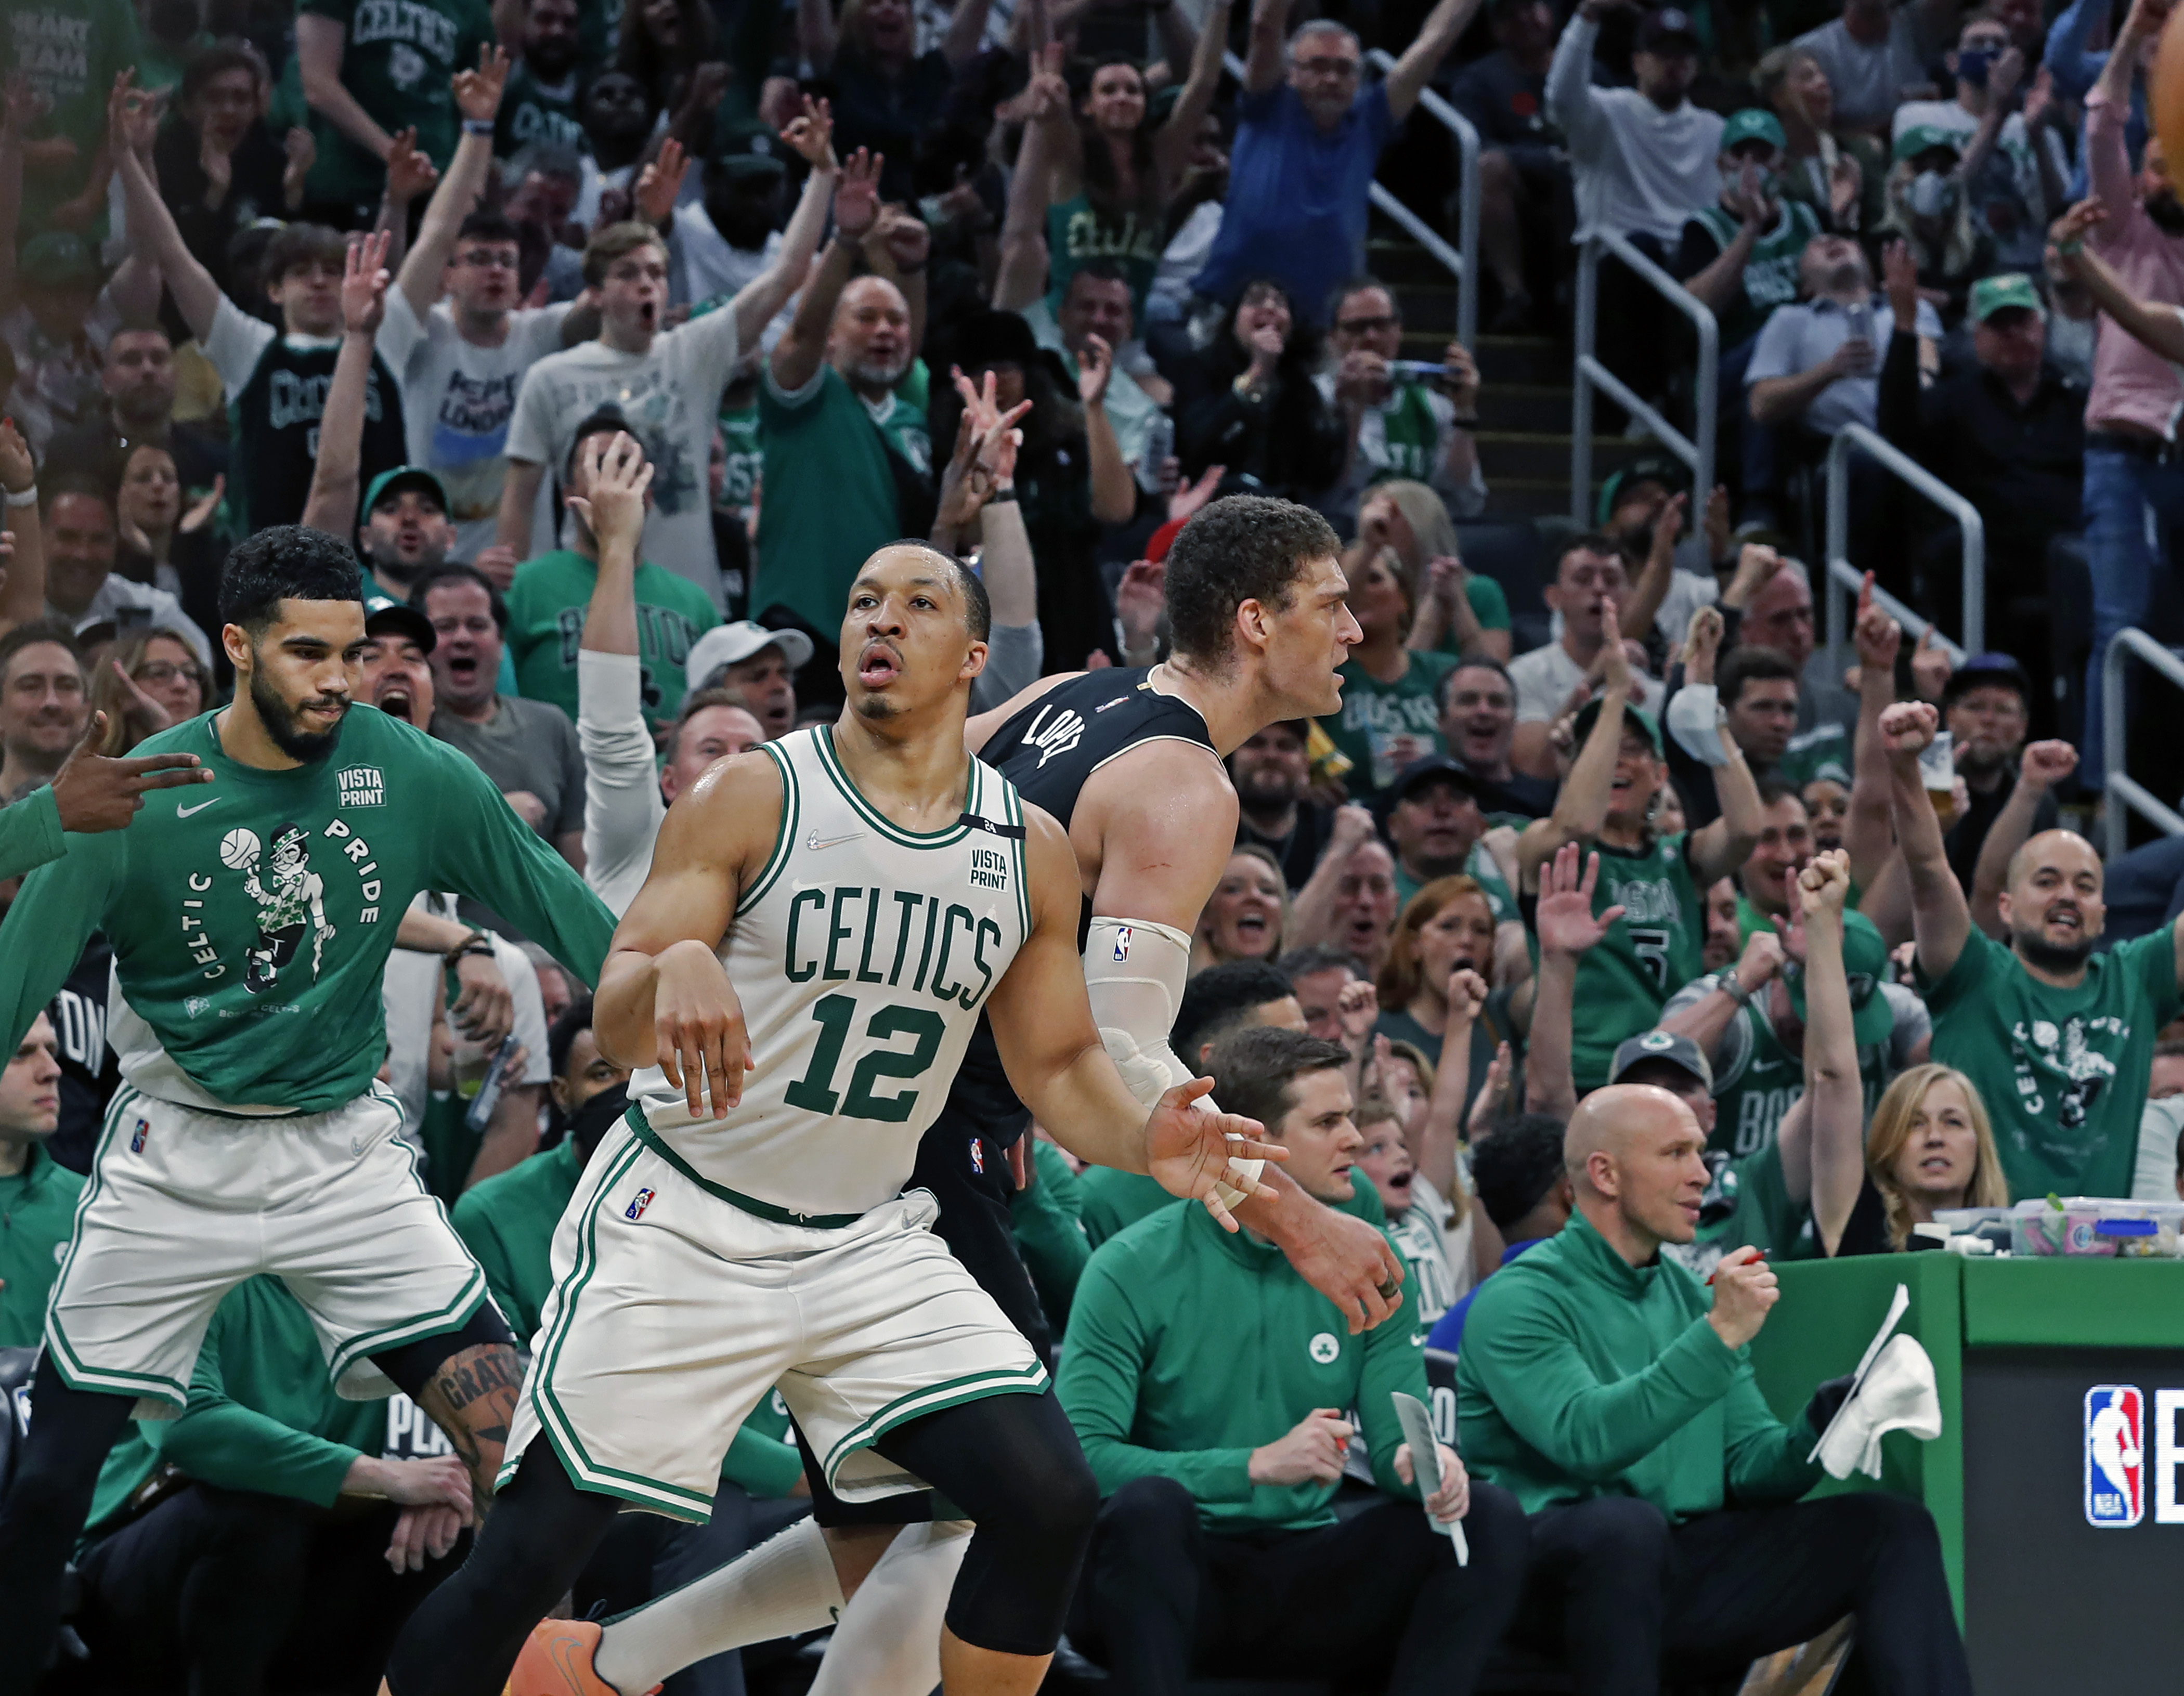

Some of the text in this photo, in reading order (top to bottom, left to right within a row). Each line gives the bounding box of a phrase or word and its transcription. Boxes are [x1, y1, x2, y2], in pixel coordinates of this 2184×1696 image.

[338, 768, 384, 790] VISTA
[340, 789, 384, 807] PRINT
[984, 819, 997, 833] 24
[323, 818, 383, 924] PRIDE
[971, 849, 1007, 873] VISTA
[969, 870, 1007, 891] PRINT
[182, 872, 226, 980] CELTIC
[785, 887, 1002, 1011] CELTICS
[784, 993, 946, 1123] 12
